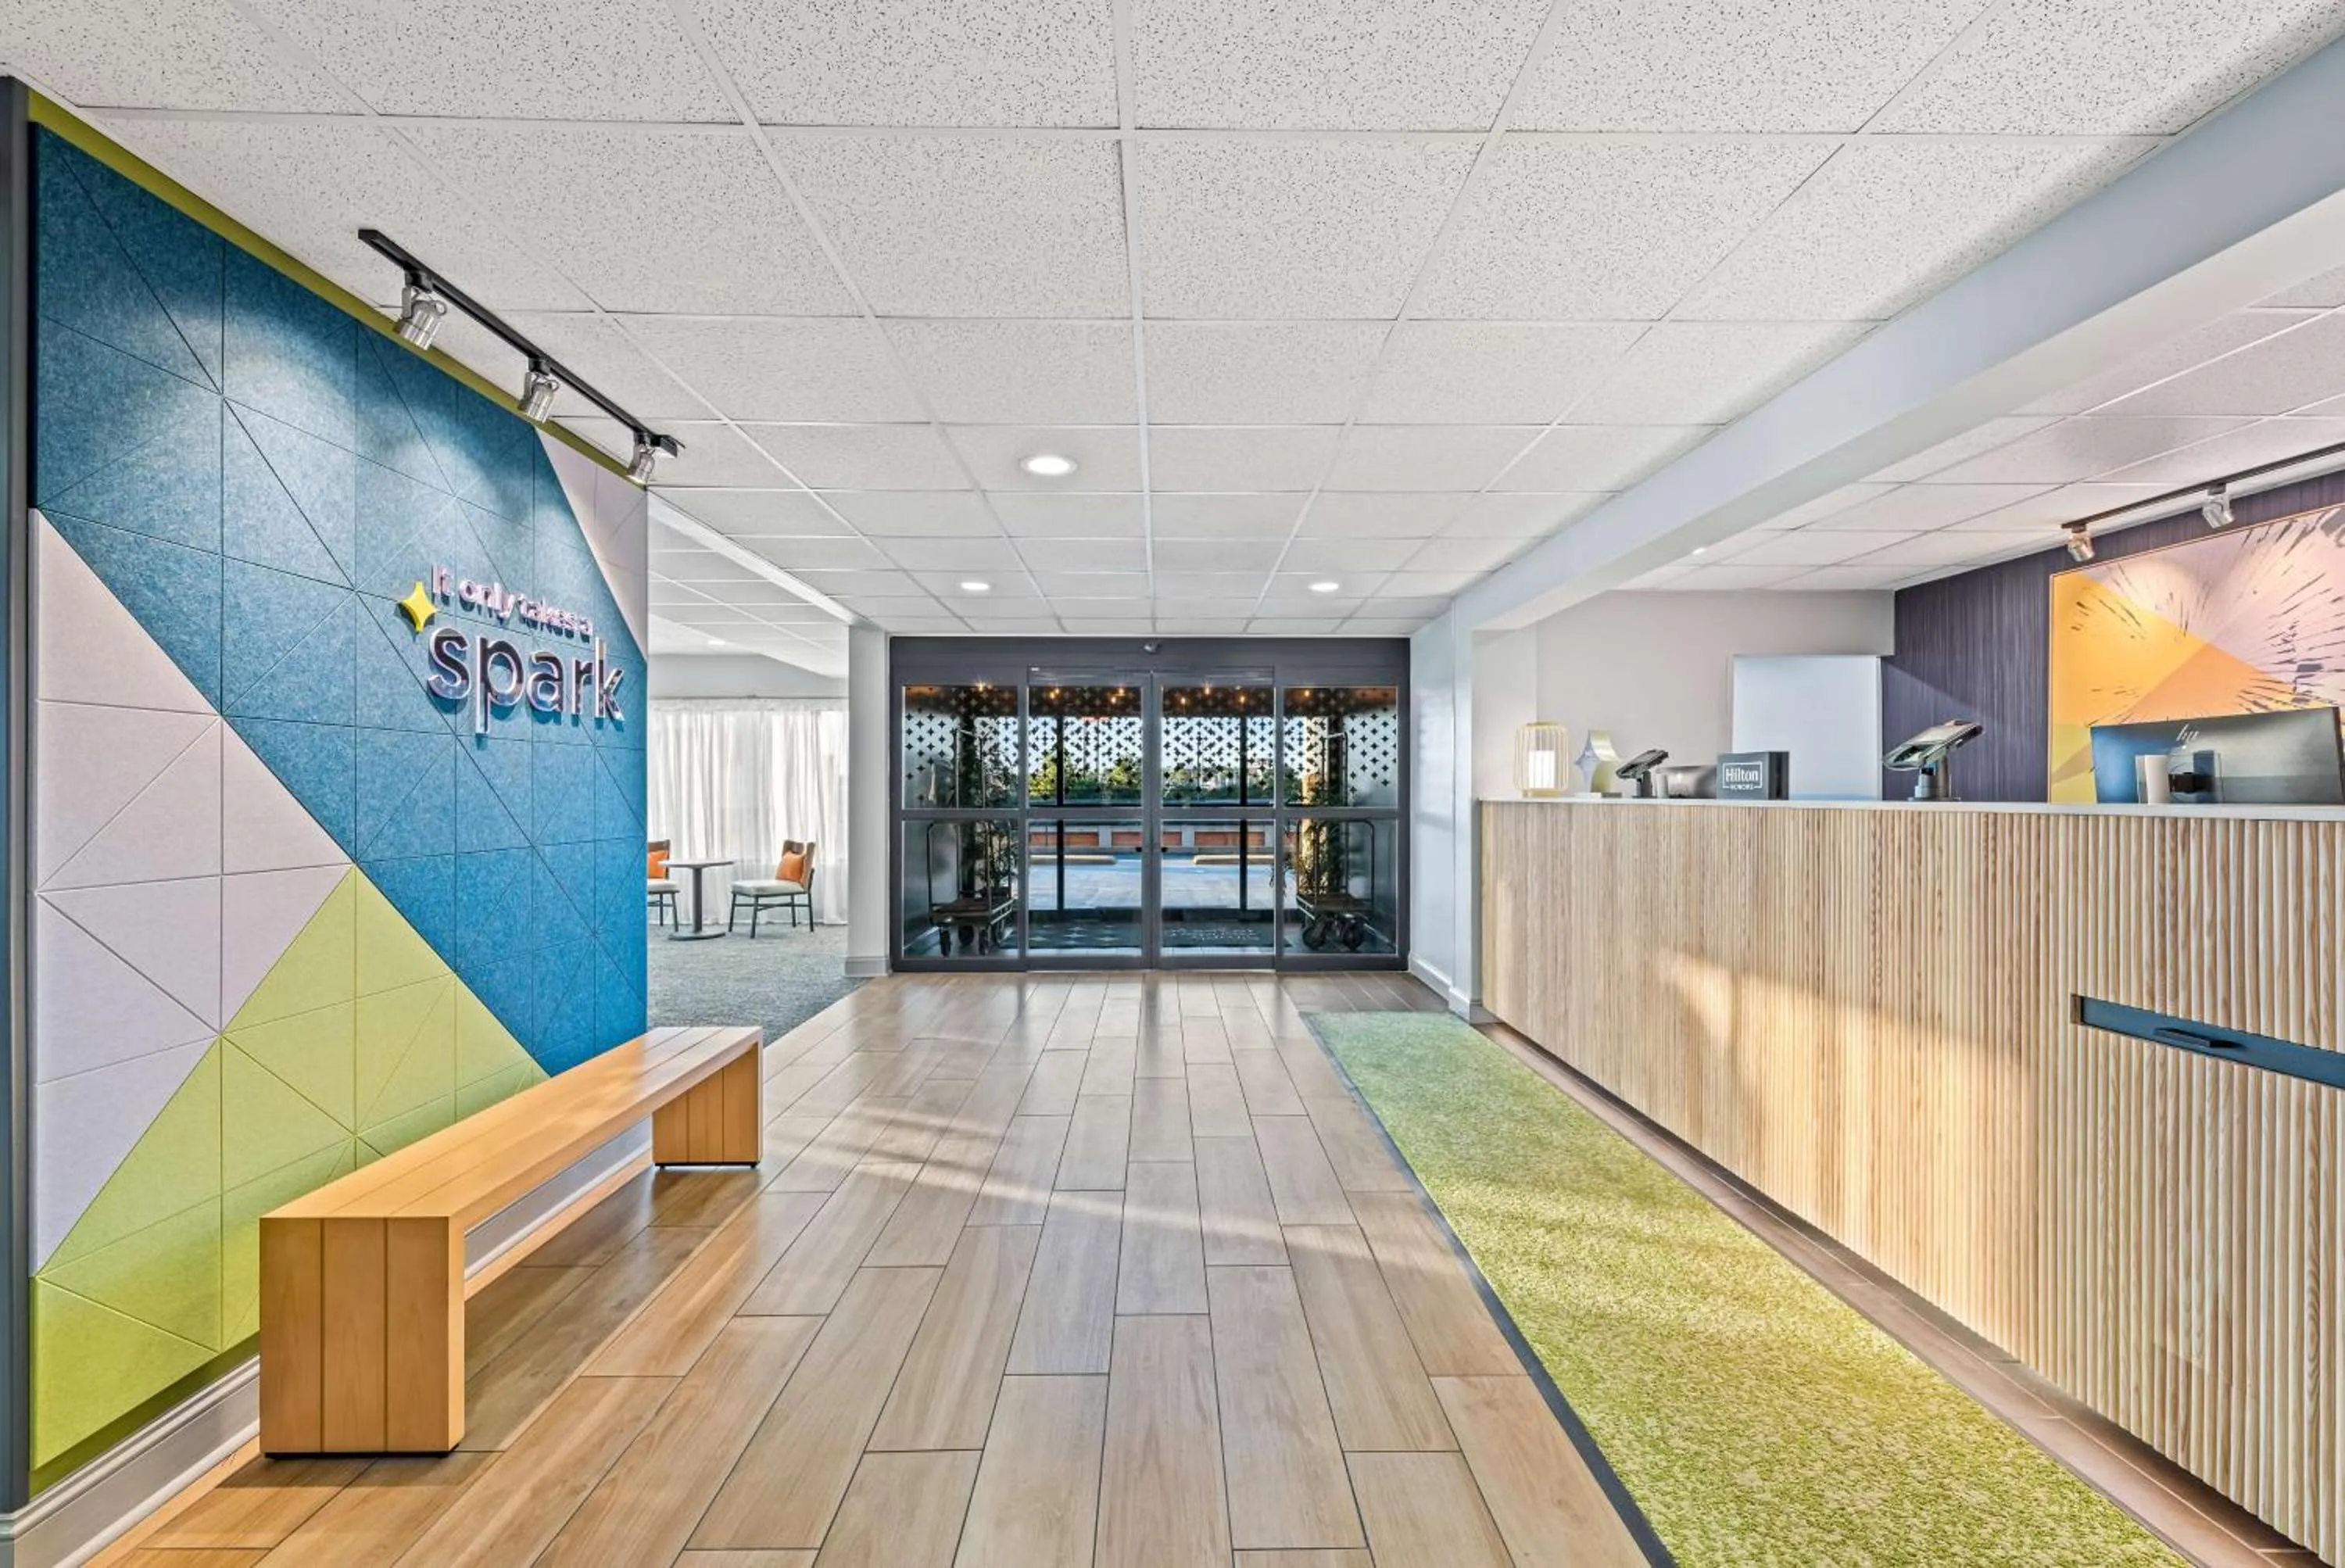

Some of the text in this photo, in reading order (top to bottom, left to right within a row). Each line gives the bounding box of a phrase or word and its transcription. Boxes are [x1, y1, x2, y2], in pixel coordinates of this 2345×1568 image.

[459, 581, 517, 618] only
[428, 628, 625, 733] spark
[1725, 767, 1759, 782] Hilton
